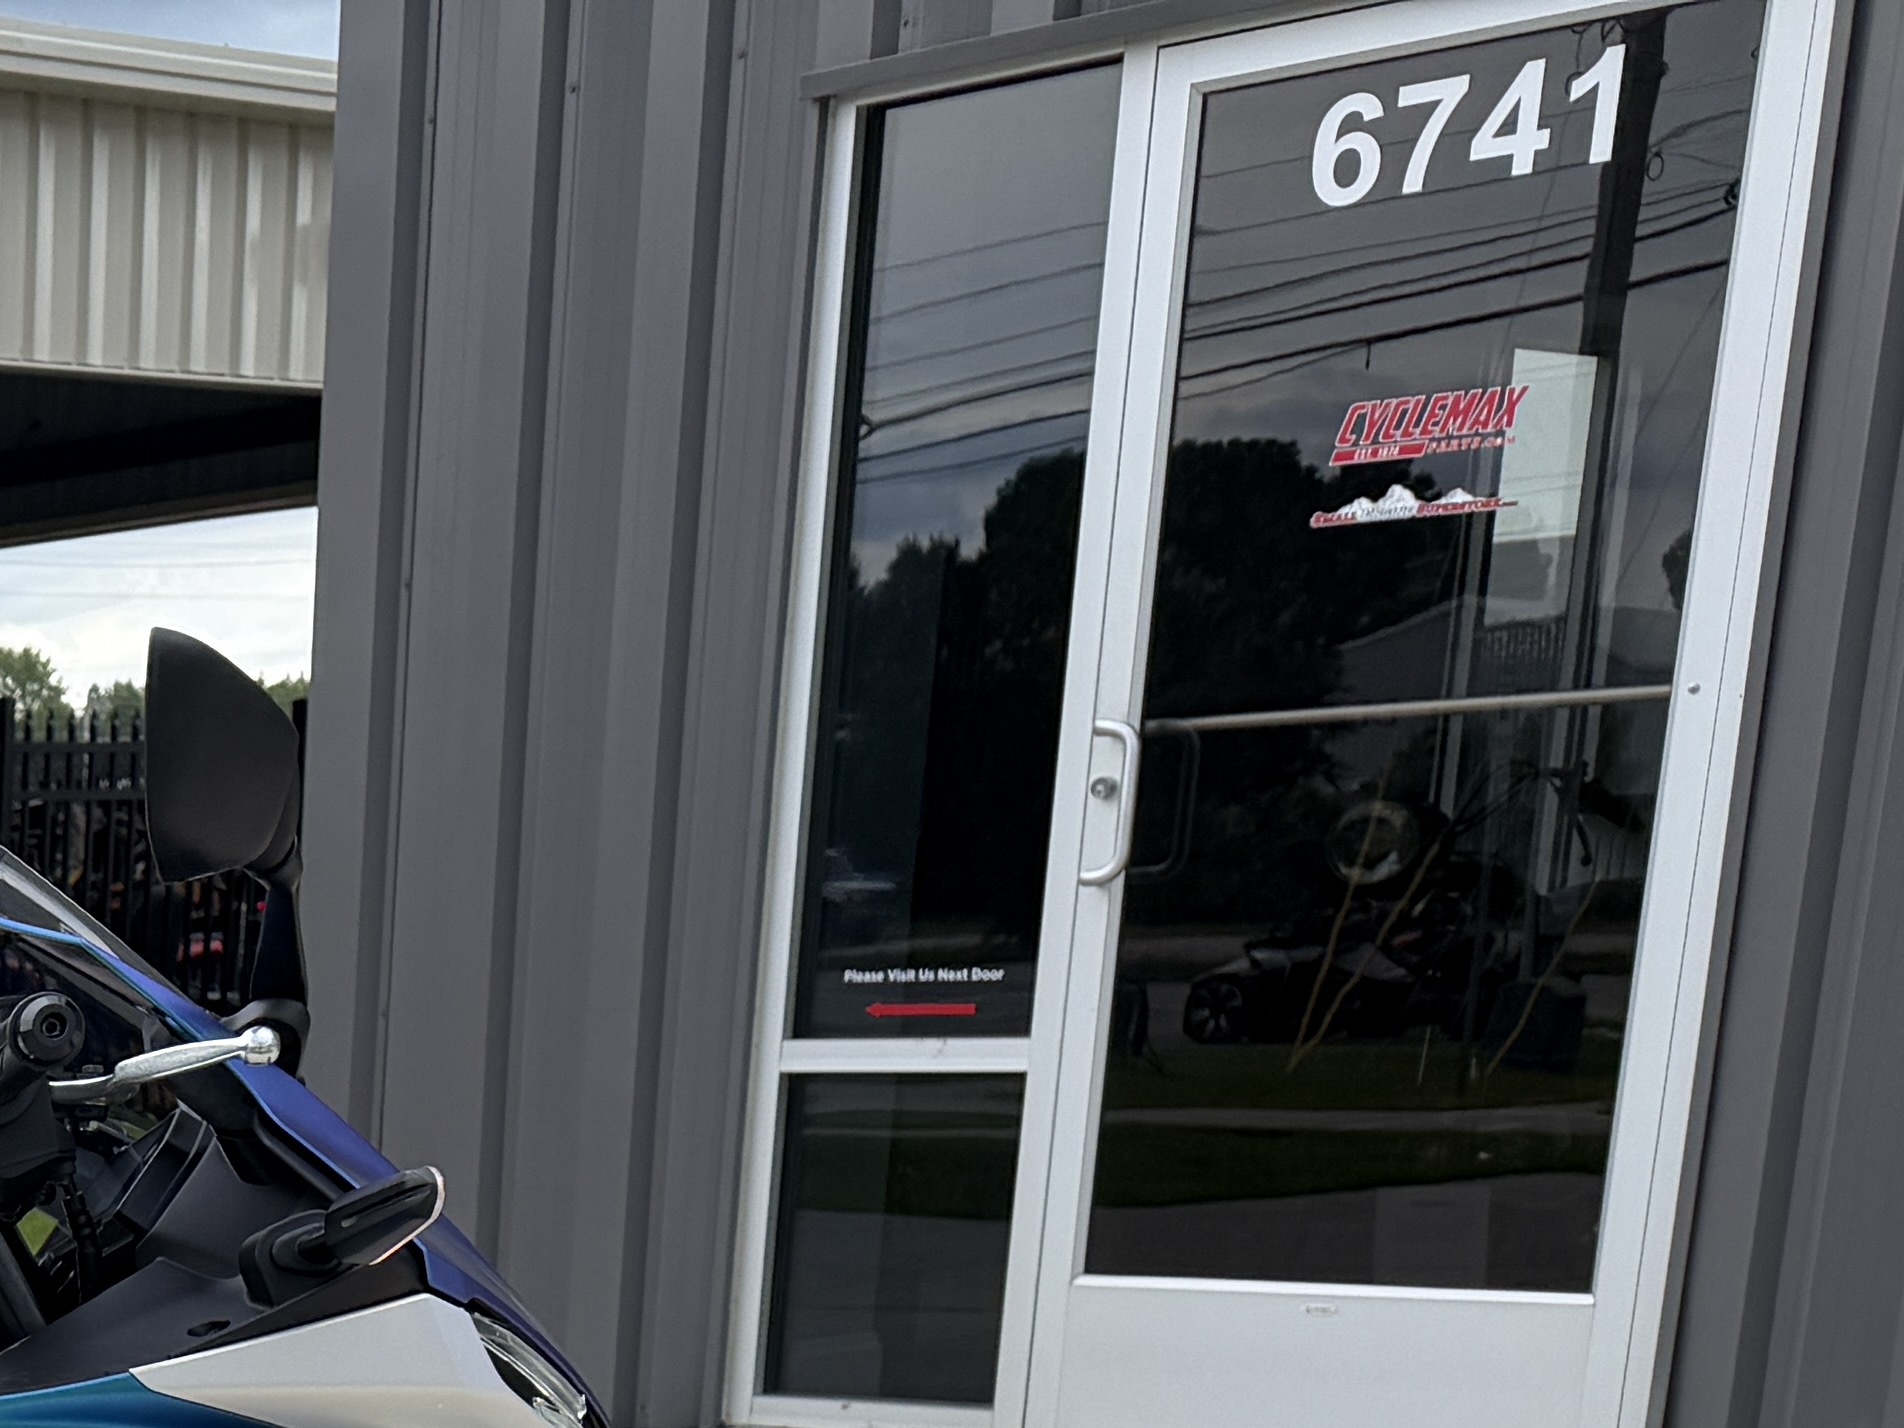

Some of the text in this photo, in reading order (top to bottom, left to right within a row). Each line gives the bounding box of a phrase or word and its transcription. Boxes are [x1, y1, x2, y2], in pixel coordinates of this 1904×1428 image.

[1311, 43, 1627, 208] 6741
[1334, 385, 1530, 447] CYCLEMAX
[843, 966, 1005, 983] Please Visit Us Next Door
